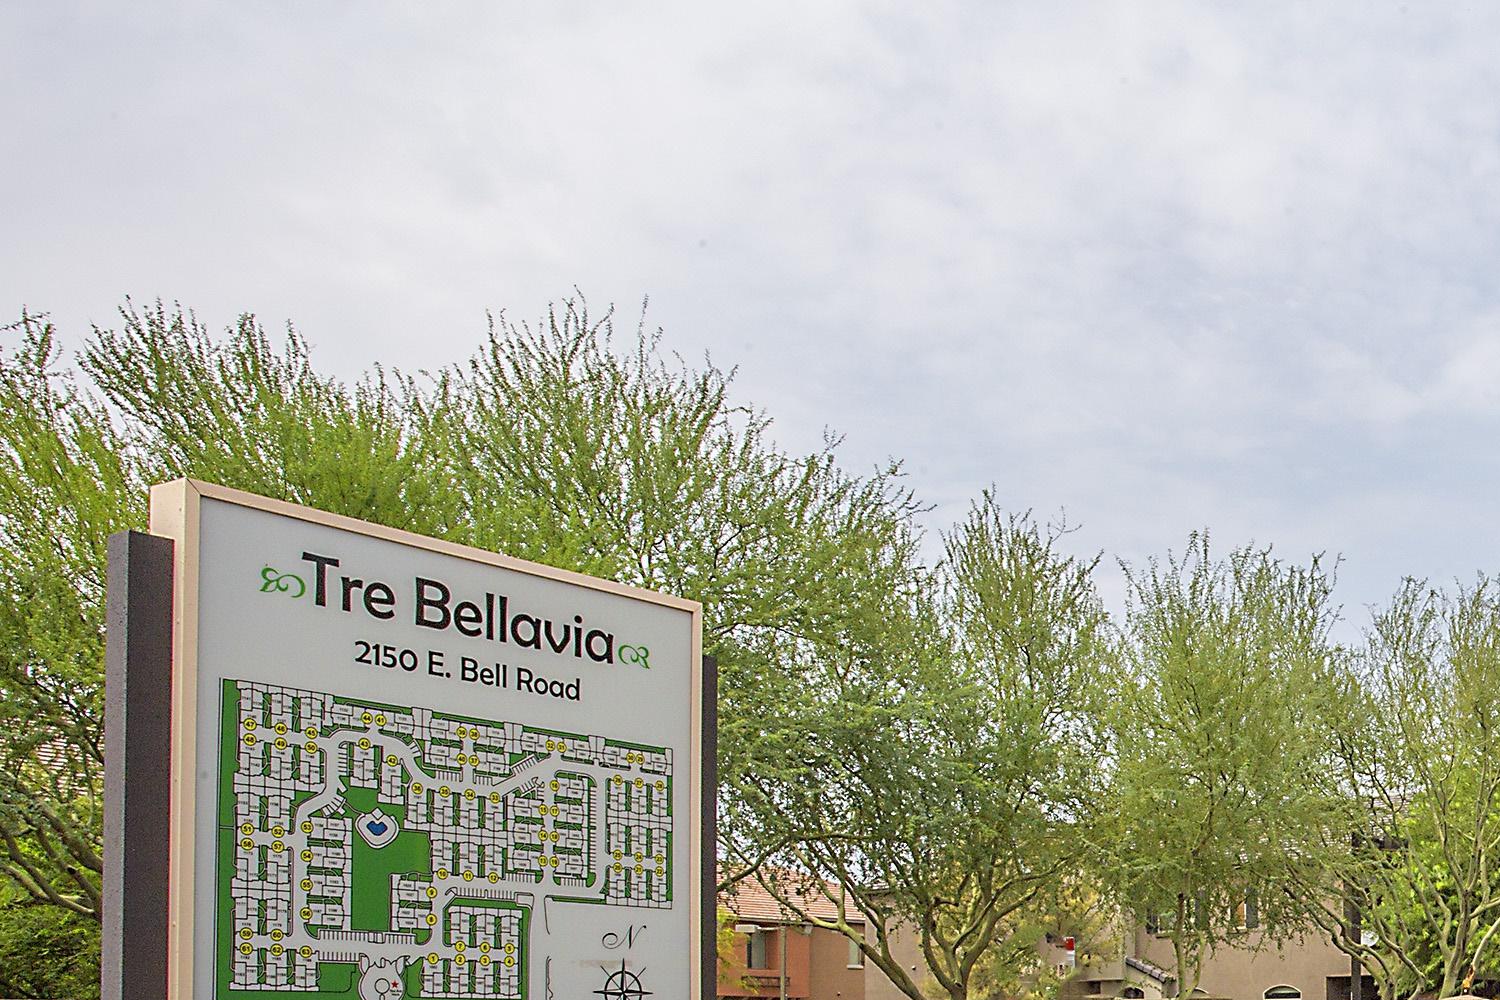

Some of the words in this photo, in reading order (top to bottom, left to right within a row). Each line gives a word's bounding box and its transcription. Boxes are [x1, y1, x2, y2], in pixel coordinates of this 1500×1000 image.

[301, 551, 396, 620] Tre
[415, 576, 614, 665] Bellavia
[354, 640, 418, 672] 2150
[428, 651, 451, 679] E.
[460, 656, 507, 688] Bell
[516, 667, 580, 701] Road
